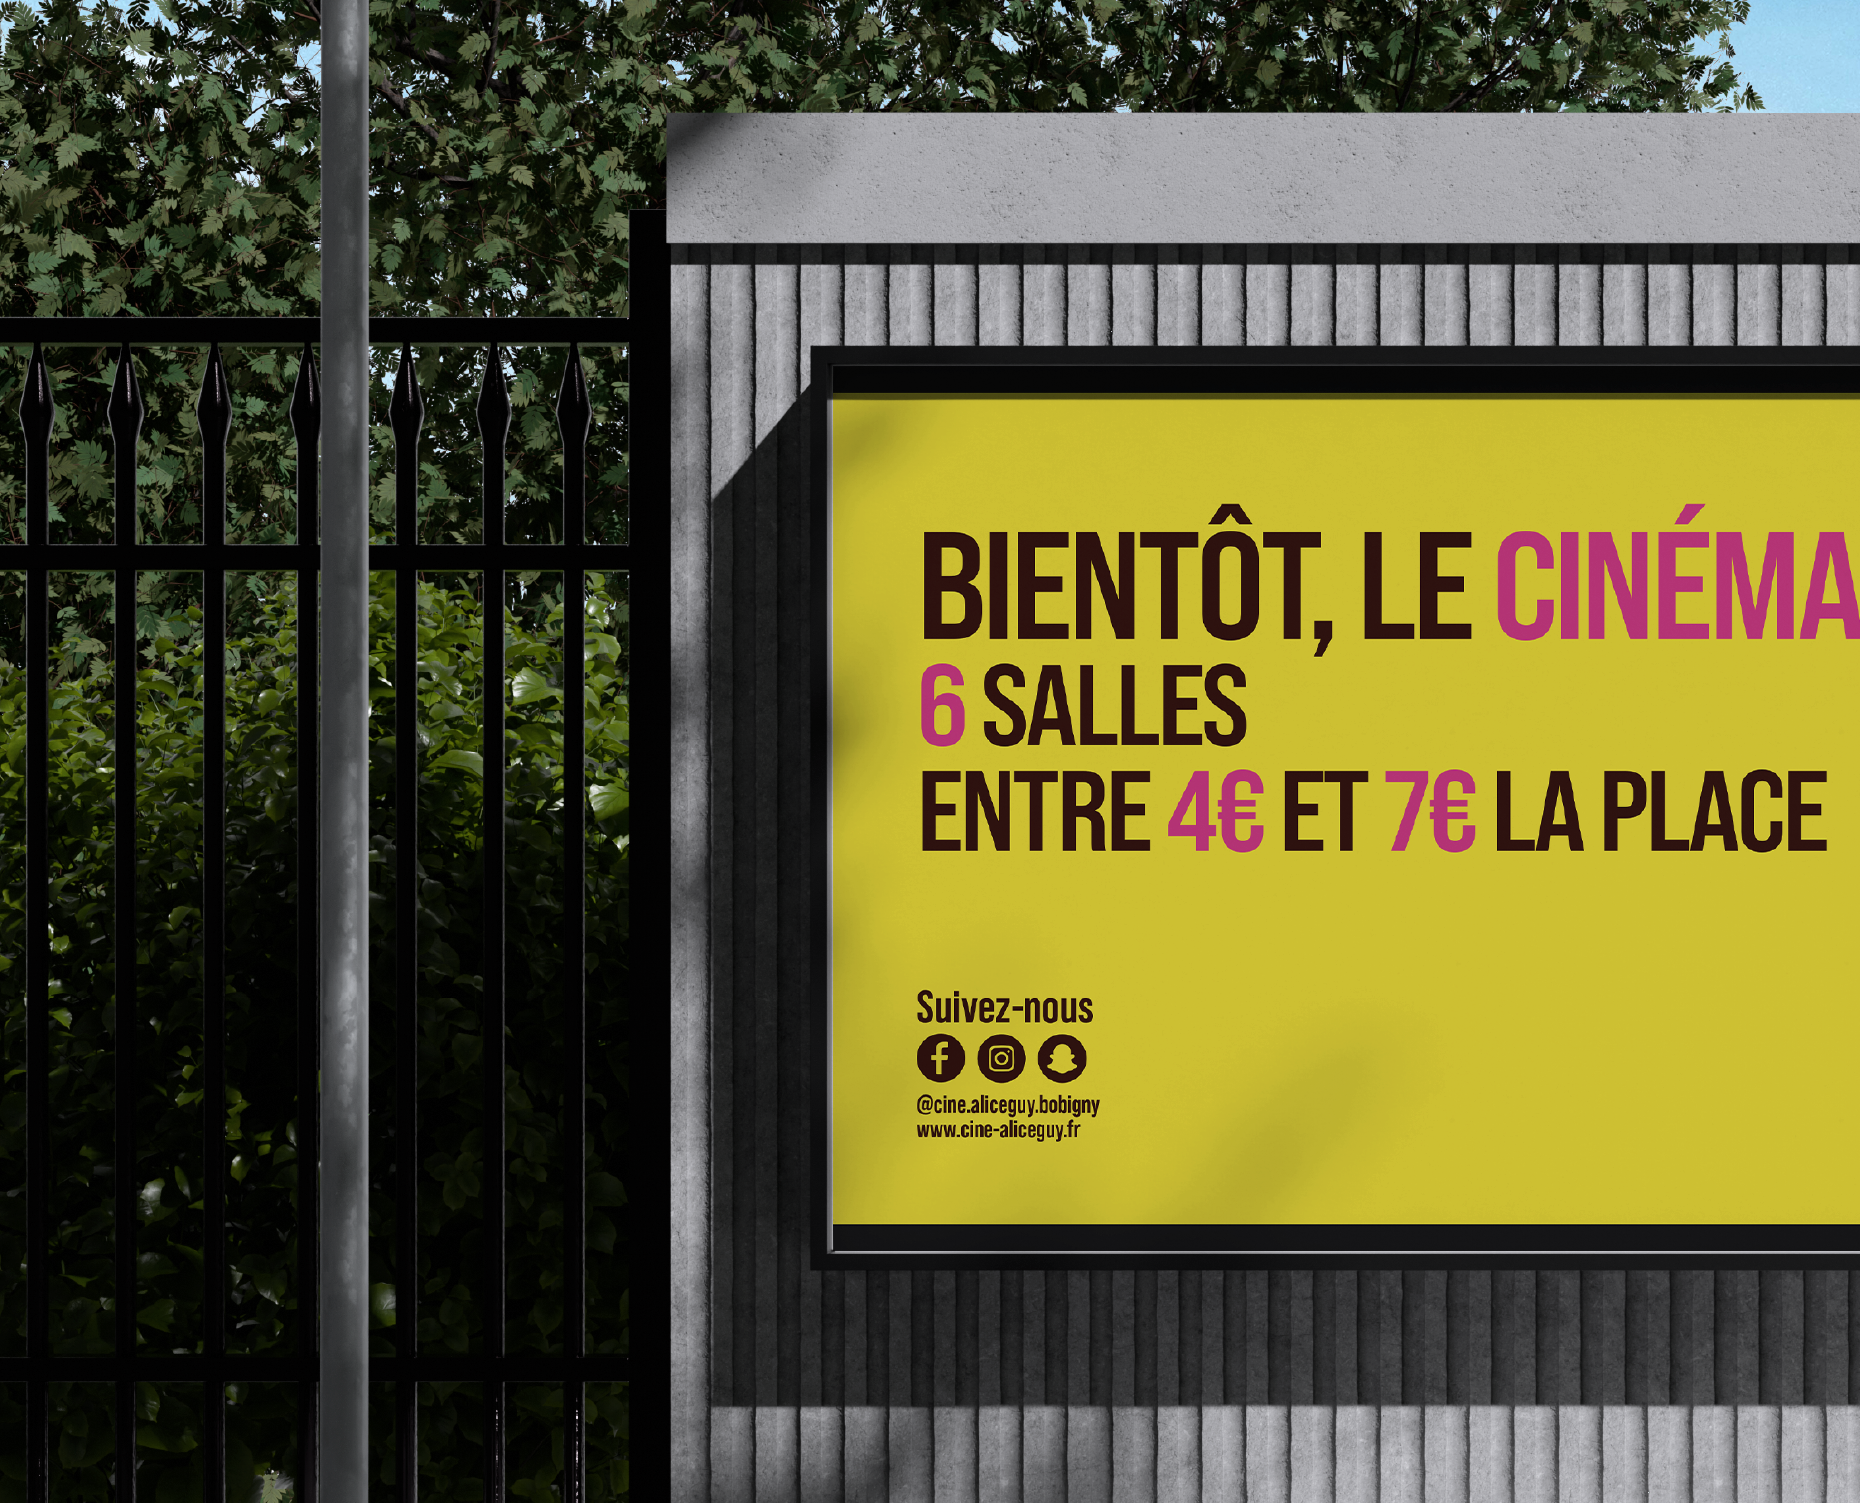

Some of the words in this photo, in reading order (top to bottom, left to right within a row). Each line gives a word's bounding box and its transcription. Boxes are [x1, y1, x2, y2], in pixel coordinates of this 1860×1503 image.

[923, 504, 1333, 658] BIENTÔT,
[1364, 531, 1472, 640] LE
[920, 662, 966, 747] 6
[983, 662, 1247, 747] SALLES
[922, 770, 1151, 852] ENTRE
[1167, 768, 1264, 853] 4€
[1284, 770, 1369, 852] ET
[1385, 768, 1476, 853] 7€
[1496, 770, 1585, 852] LA
[1603, 768, 1828, 853] PLACE
[916, 989, 1094, 1024] Suivez-nous
[916, 1093, 1101, 1117] @cine.aliceguy.bobigny
[916, 1119, 1081, 1143] www.cine-aliceguy.fr
